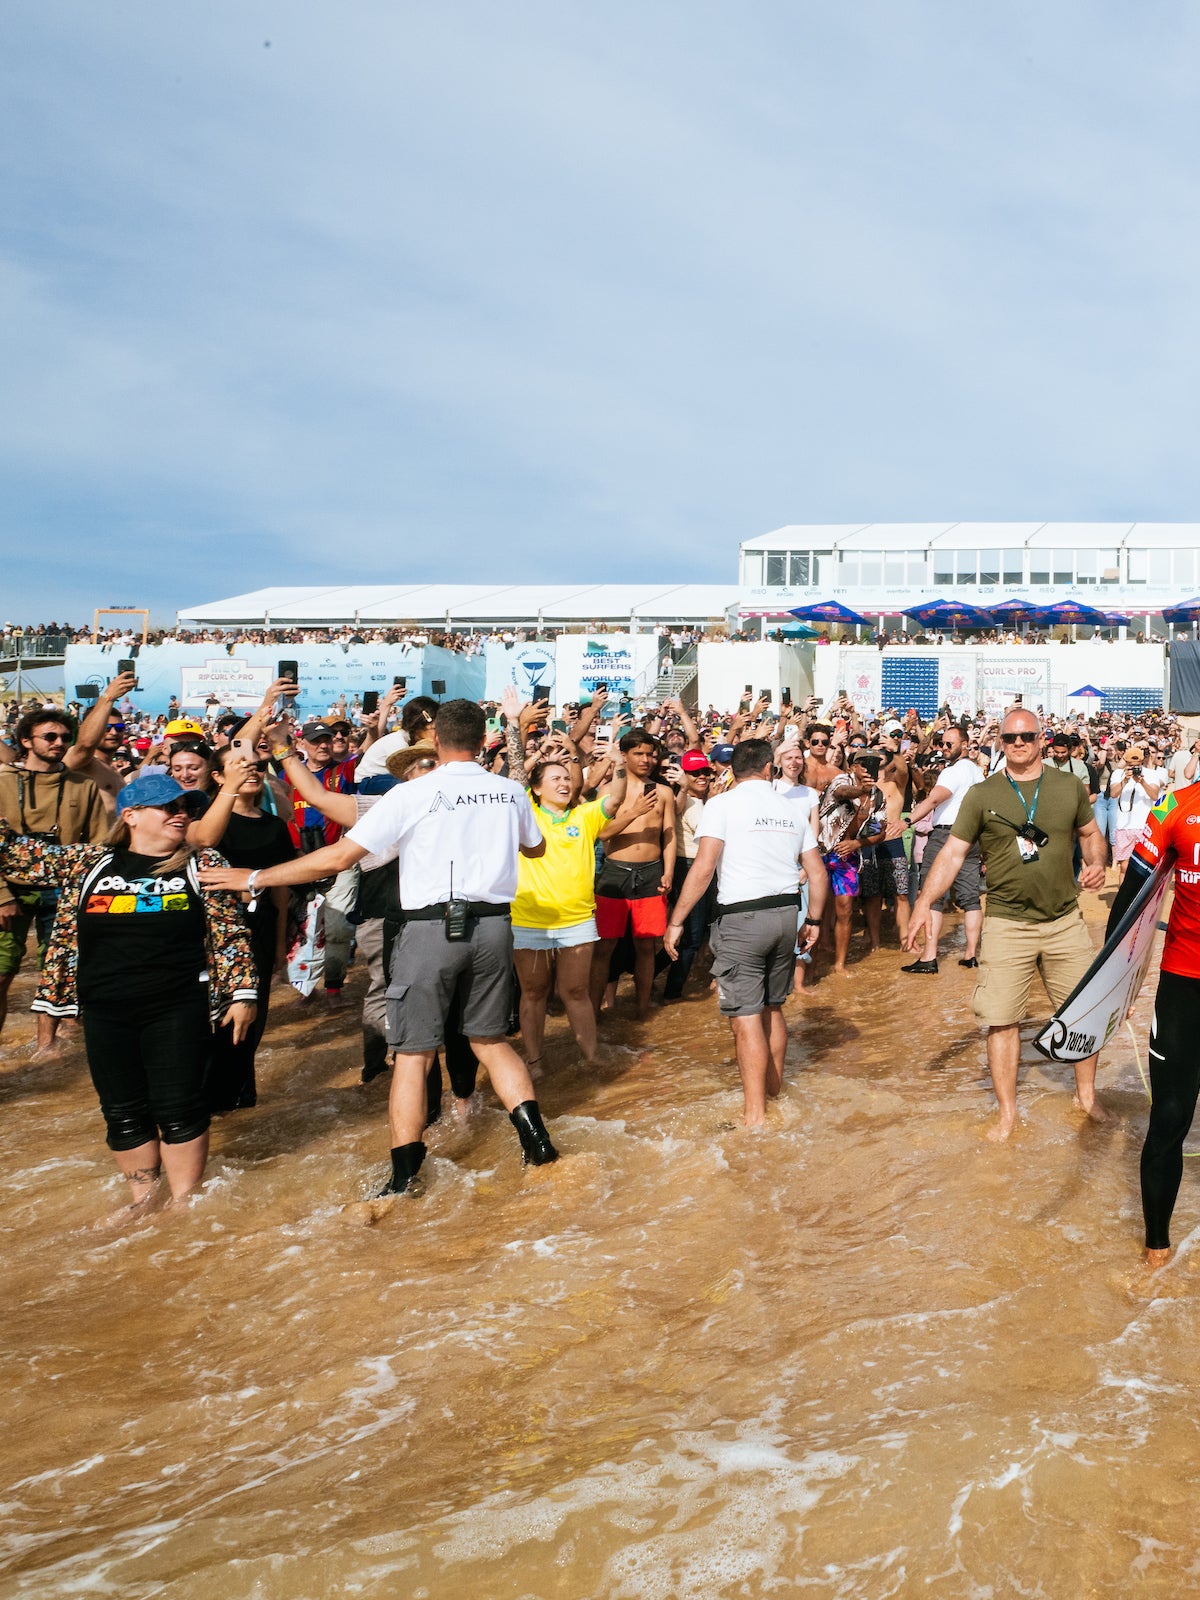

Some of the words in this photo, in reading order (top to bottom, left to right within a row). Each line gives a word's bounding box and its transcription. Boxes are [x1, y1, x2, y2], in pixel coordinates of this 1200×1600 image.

[456, 793, 517, 805] ANTHEA
[755, 817, 794, 828] ANTHEA
[92, 875, 187, 895] peniche
[1065, 1031, 1086, 1053] CURL
